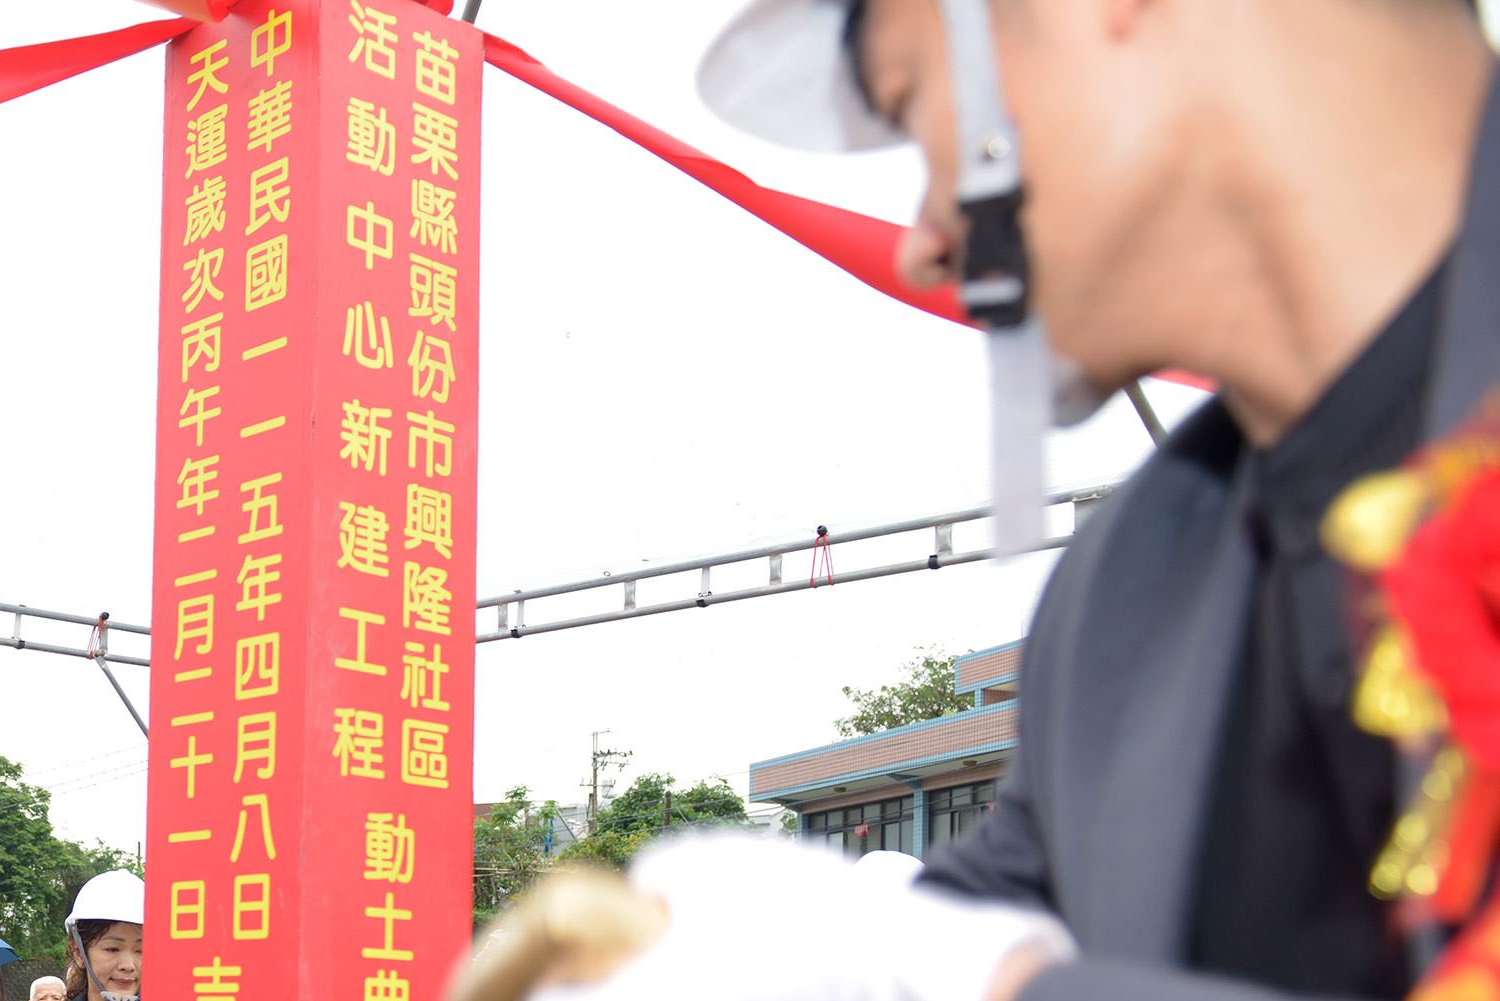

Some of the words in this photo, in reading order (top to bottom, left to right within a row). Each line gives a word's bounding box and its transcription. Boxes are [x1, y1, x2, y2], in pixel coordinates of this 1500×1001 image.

[169, 40, 229, 940] 天運歲次丙午年二月二十一日
[230, 10, 293, 940] 中華民國一一五年四月八日
[333, 0, 398, 780] 活動中心新建工程
[401, 30, 460, 789] 苗栗縣頭份市興隆社區
